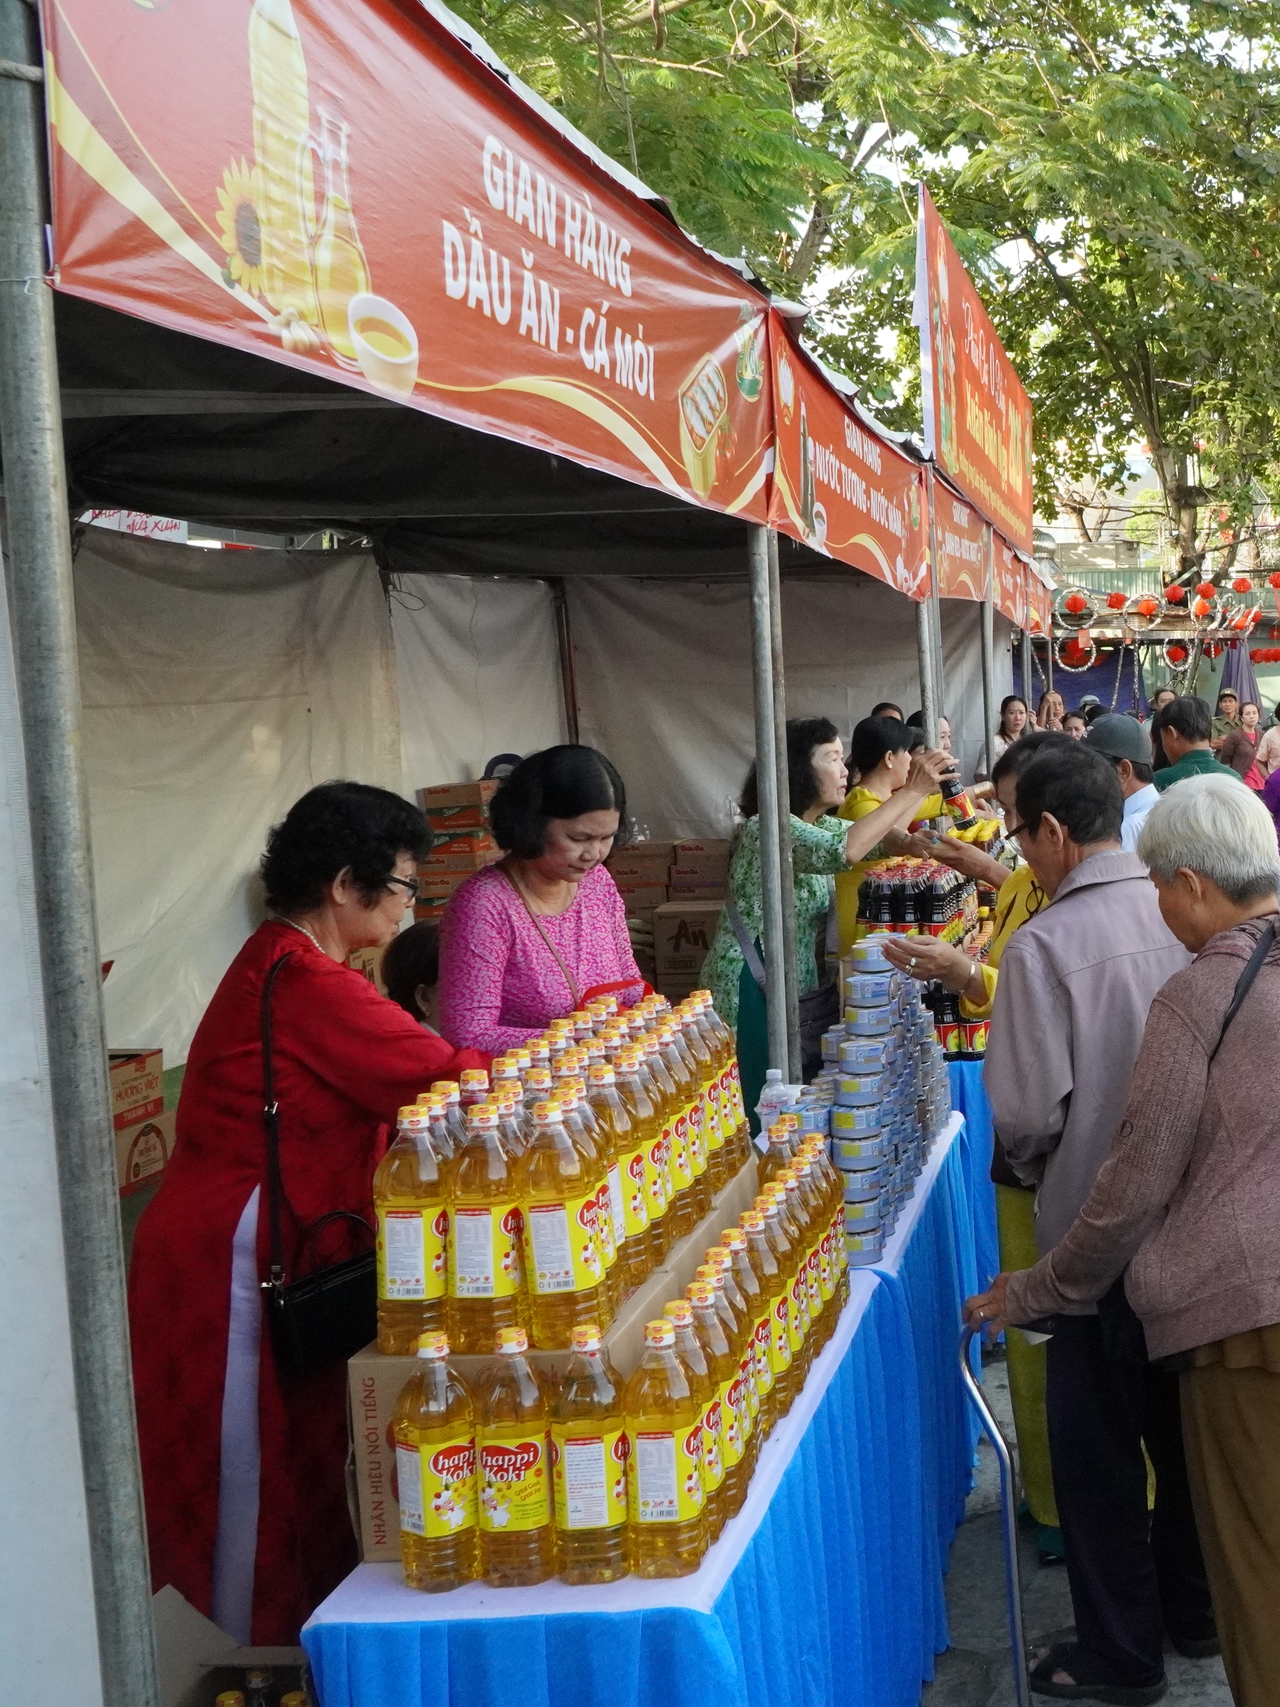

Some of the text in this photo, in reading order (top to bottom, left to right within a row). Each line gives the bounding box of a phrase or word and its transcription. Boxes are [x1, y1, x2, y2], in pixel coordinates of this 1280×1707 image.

[483, 134, 632, 298] GIAN HÀNG
[442, 206, 511, 326] DẦU
[519, 246, 560, 353] ĂN
[579, 300, 610, 379] CÁ
[844, 414, 862, 460] GIAN
[816, 441, 840, 494] NƯỚC
[841, 462, 867, 514] TƯƠNG
[482, 1447, 534, 1468] happi
[485, 1466, 526, 1483] Koki
